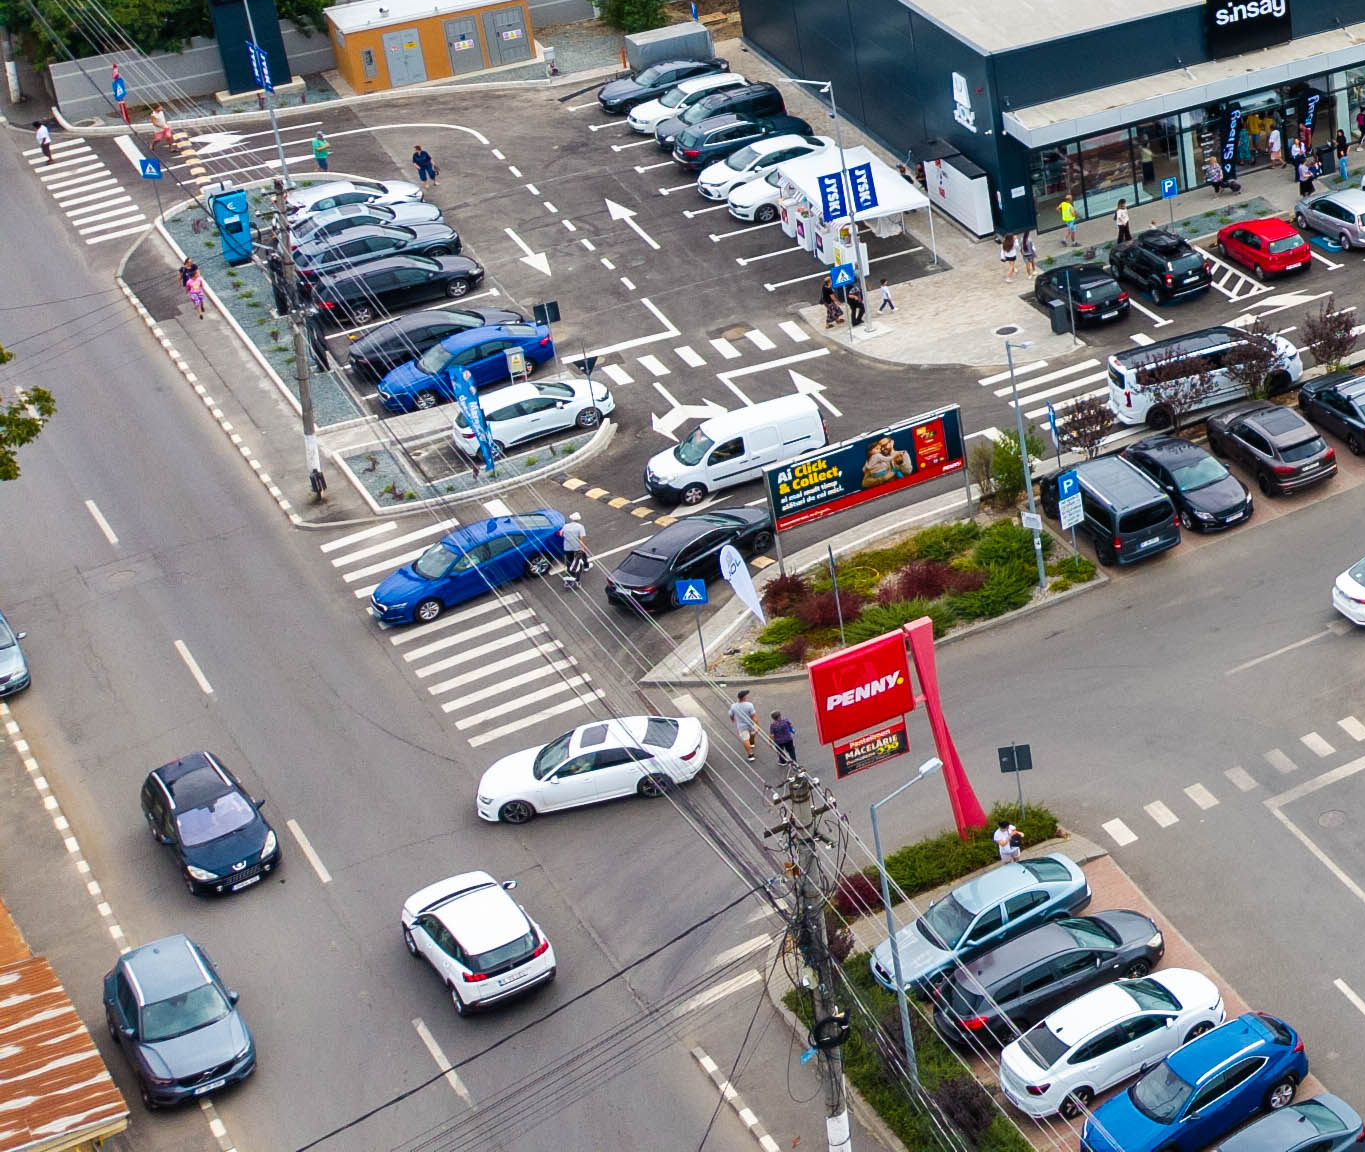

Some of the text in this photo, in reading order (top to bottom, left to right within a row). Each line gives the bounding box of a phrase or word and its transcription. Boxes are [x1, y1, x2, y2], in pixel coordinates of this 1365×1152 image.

[824, 178, 840, 216] JYSK
[855, 169, 872, 207] JYSK
[1164, 180, 1174, 193] P
[778, 459, 828, 484] Ai Click
[779, 465, 843, 495] & Collect,
[1063, 478, 1074, 494] P
